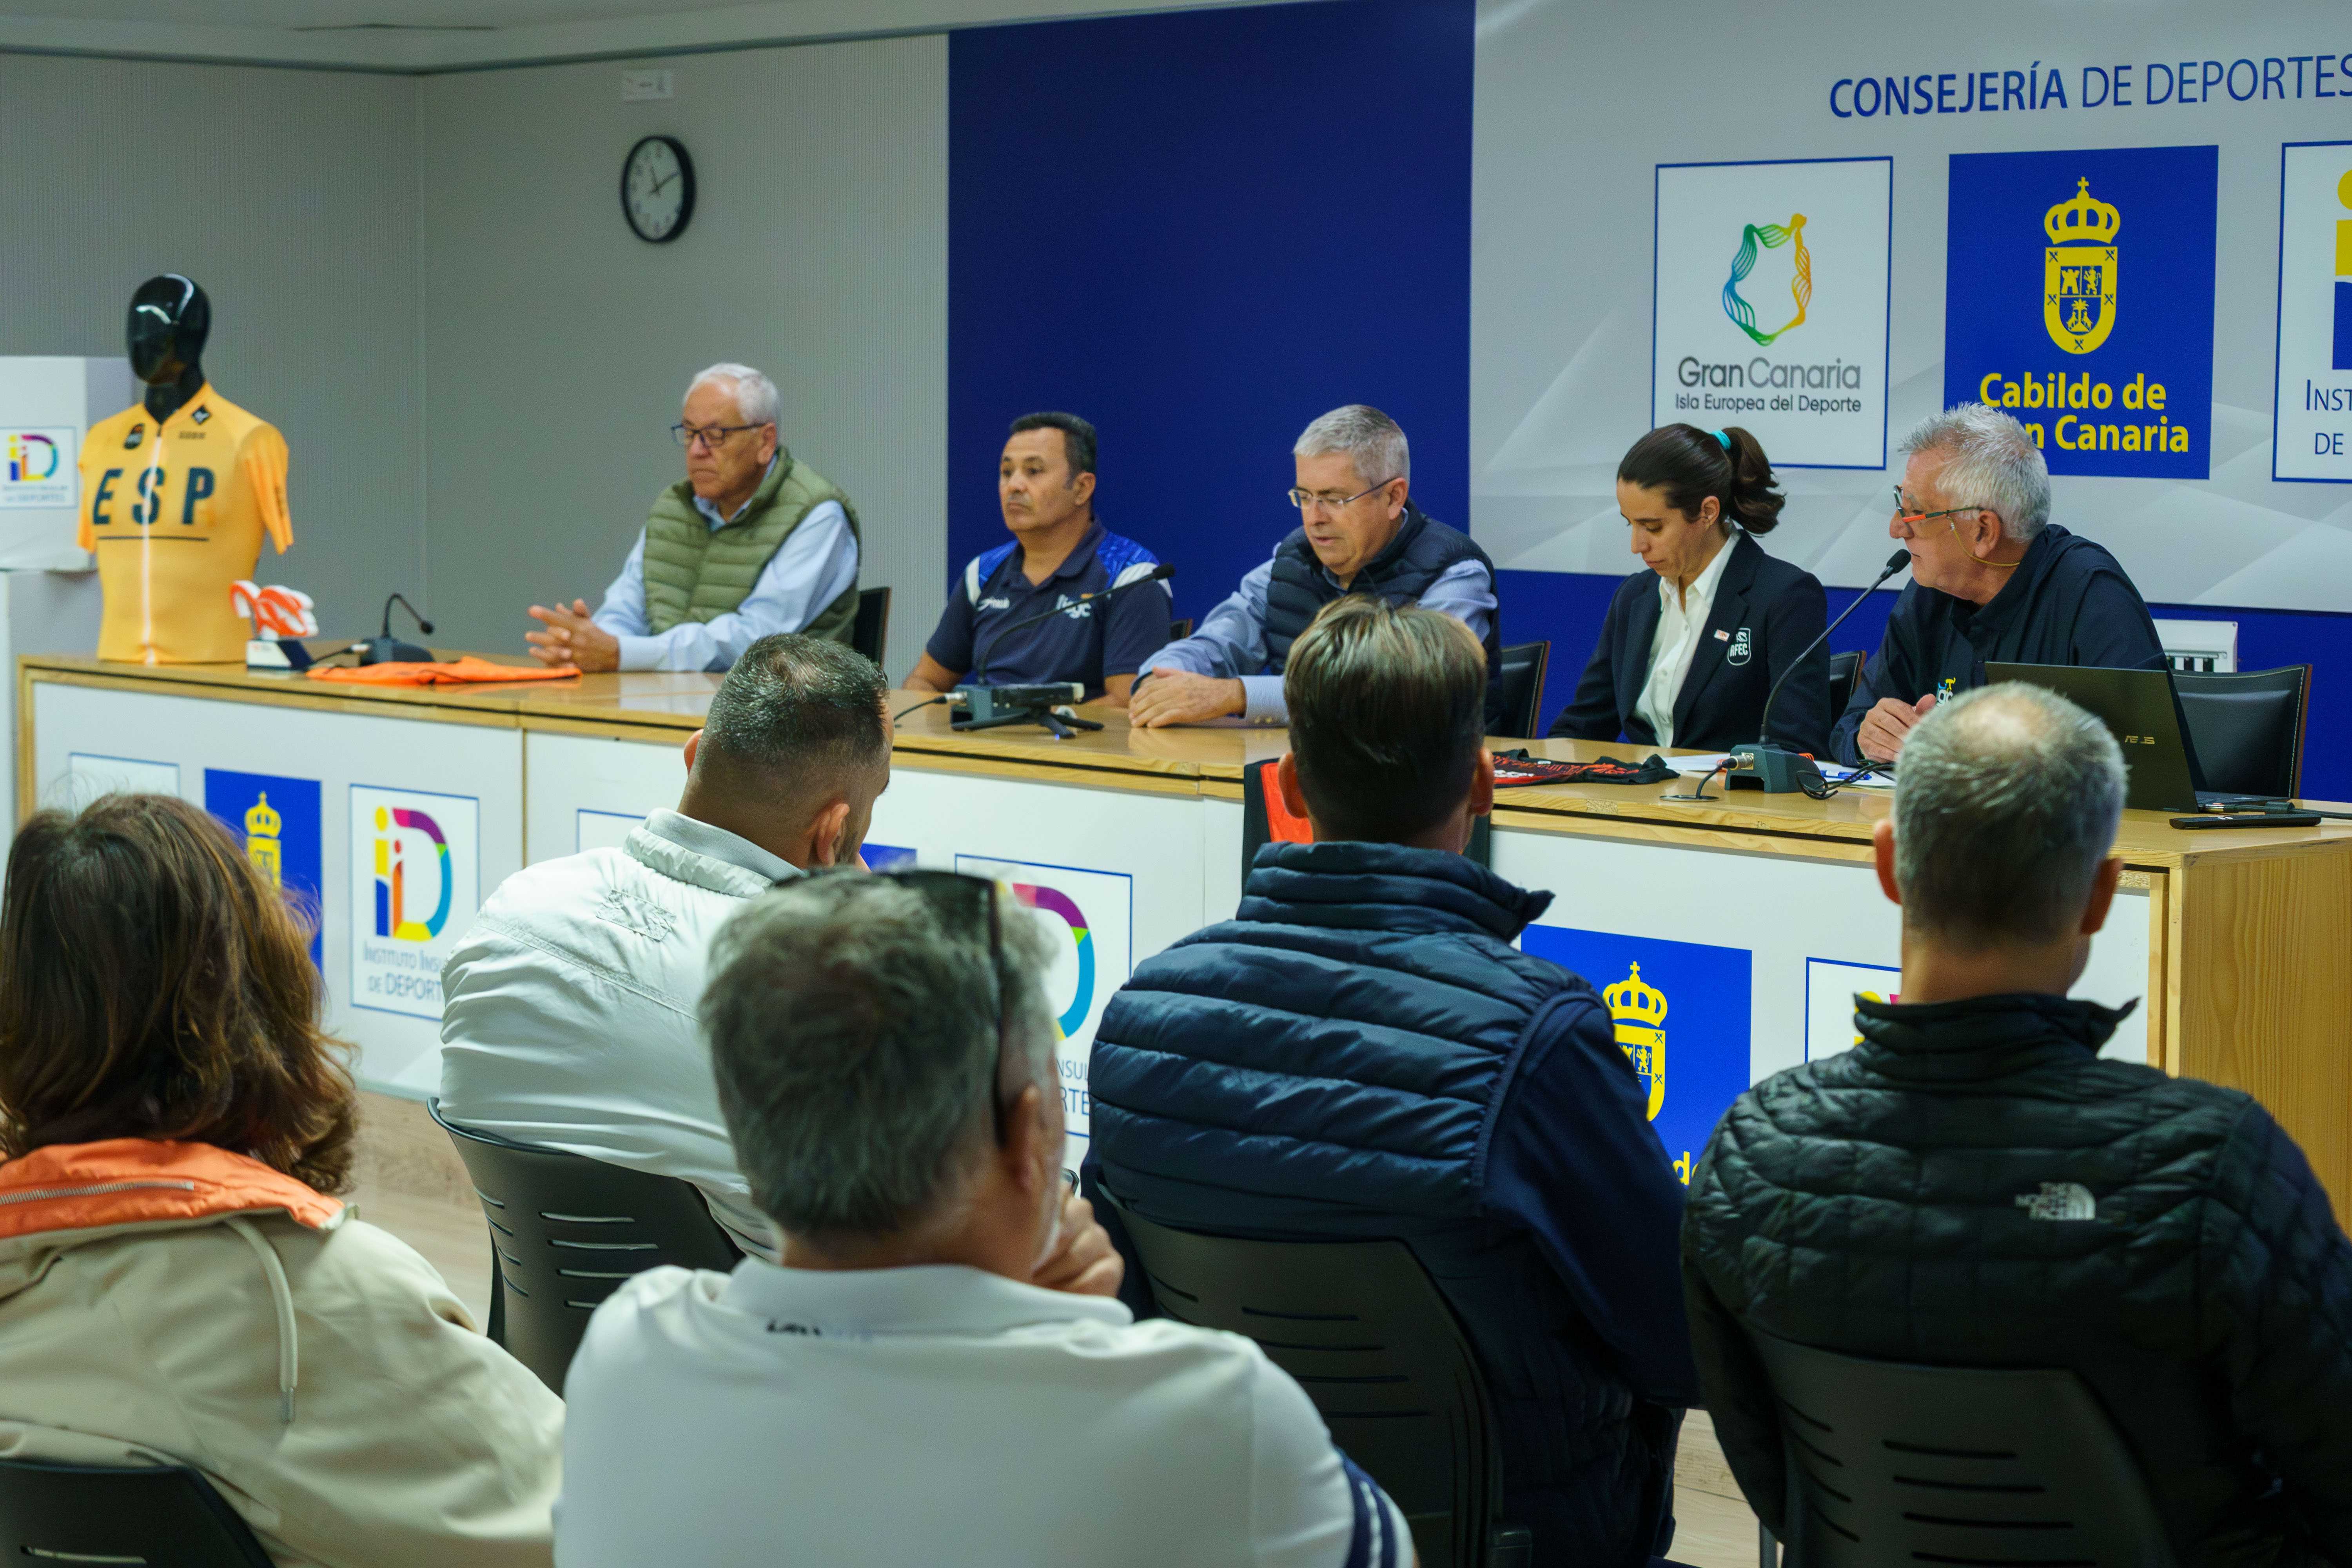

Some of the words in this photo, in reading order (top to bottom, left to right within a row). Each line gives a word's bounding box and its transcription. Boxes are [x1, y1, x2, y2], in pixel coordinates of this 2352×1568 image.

[1829, 61, 2069, 118] CONSEJERÍA
[2082, 66, 2132, 108] DE
[1679, 356, 1743, 387] Gran
[1748, 357, 1861, 389] Canaria
[1980, 372, 2113, 409] Cabildo
[2122, 373, 2167, 410] de
[1675, 393, 1699, 410] Isla
[1704, 394, 1765, 414] Europea
[1770, 395, 1793, 411] del
[1798, 395, 1861, 415] Deporte
[2055, 415, 2189, 453] Canaria
[93, 467, 215, 526] ESP
